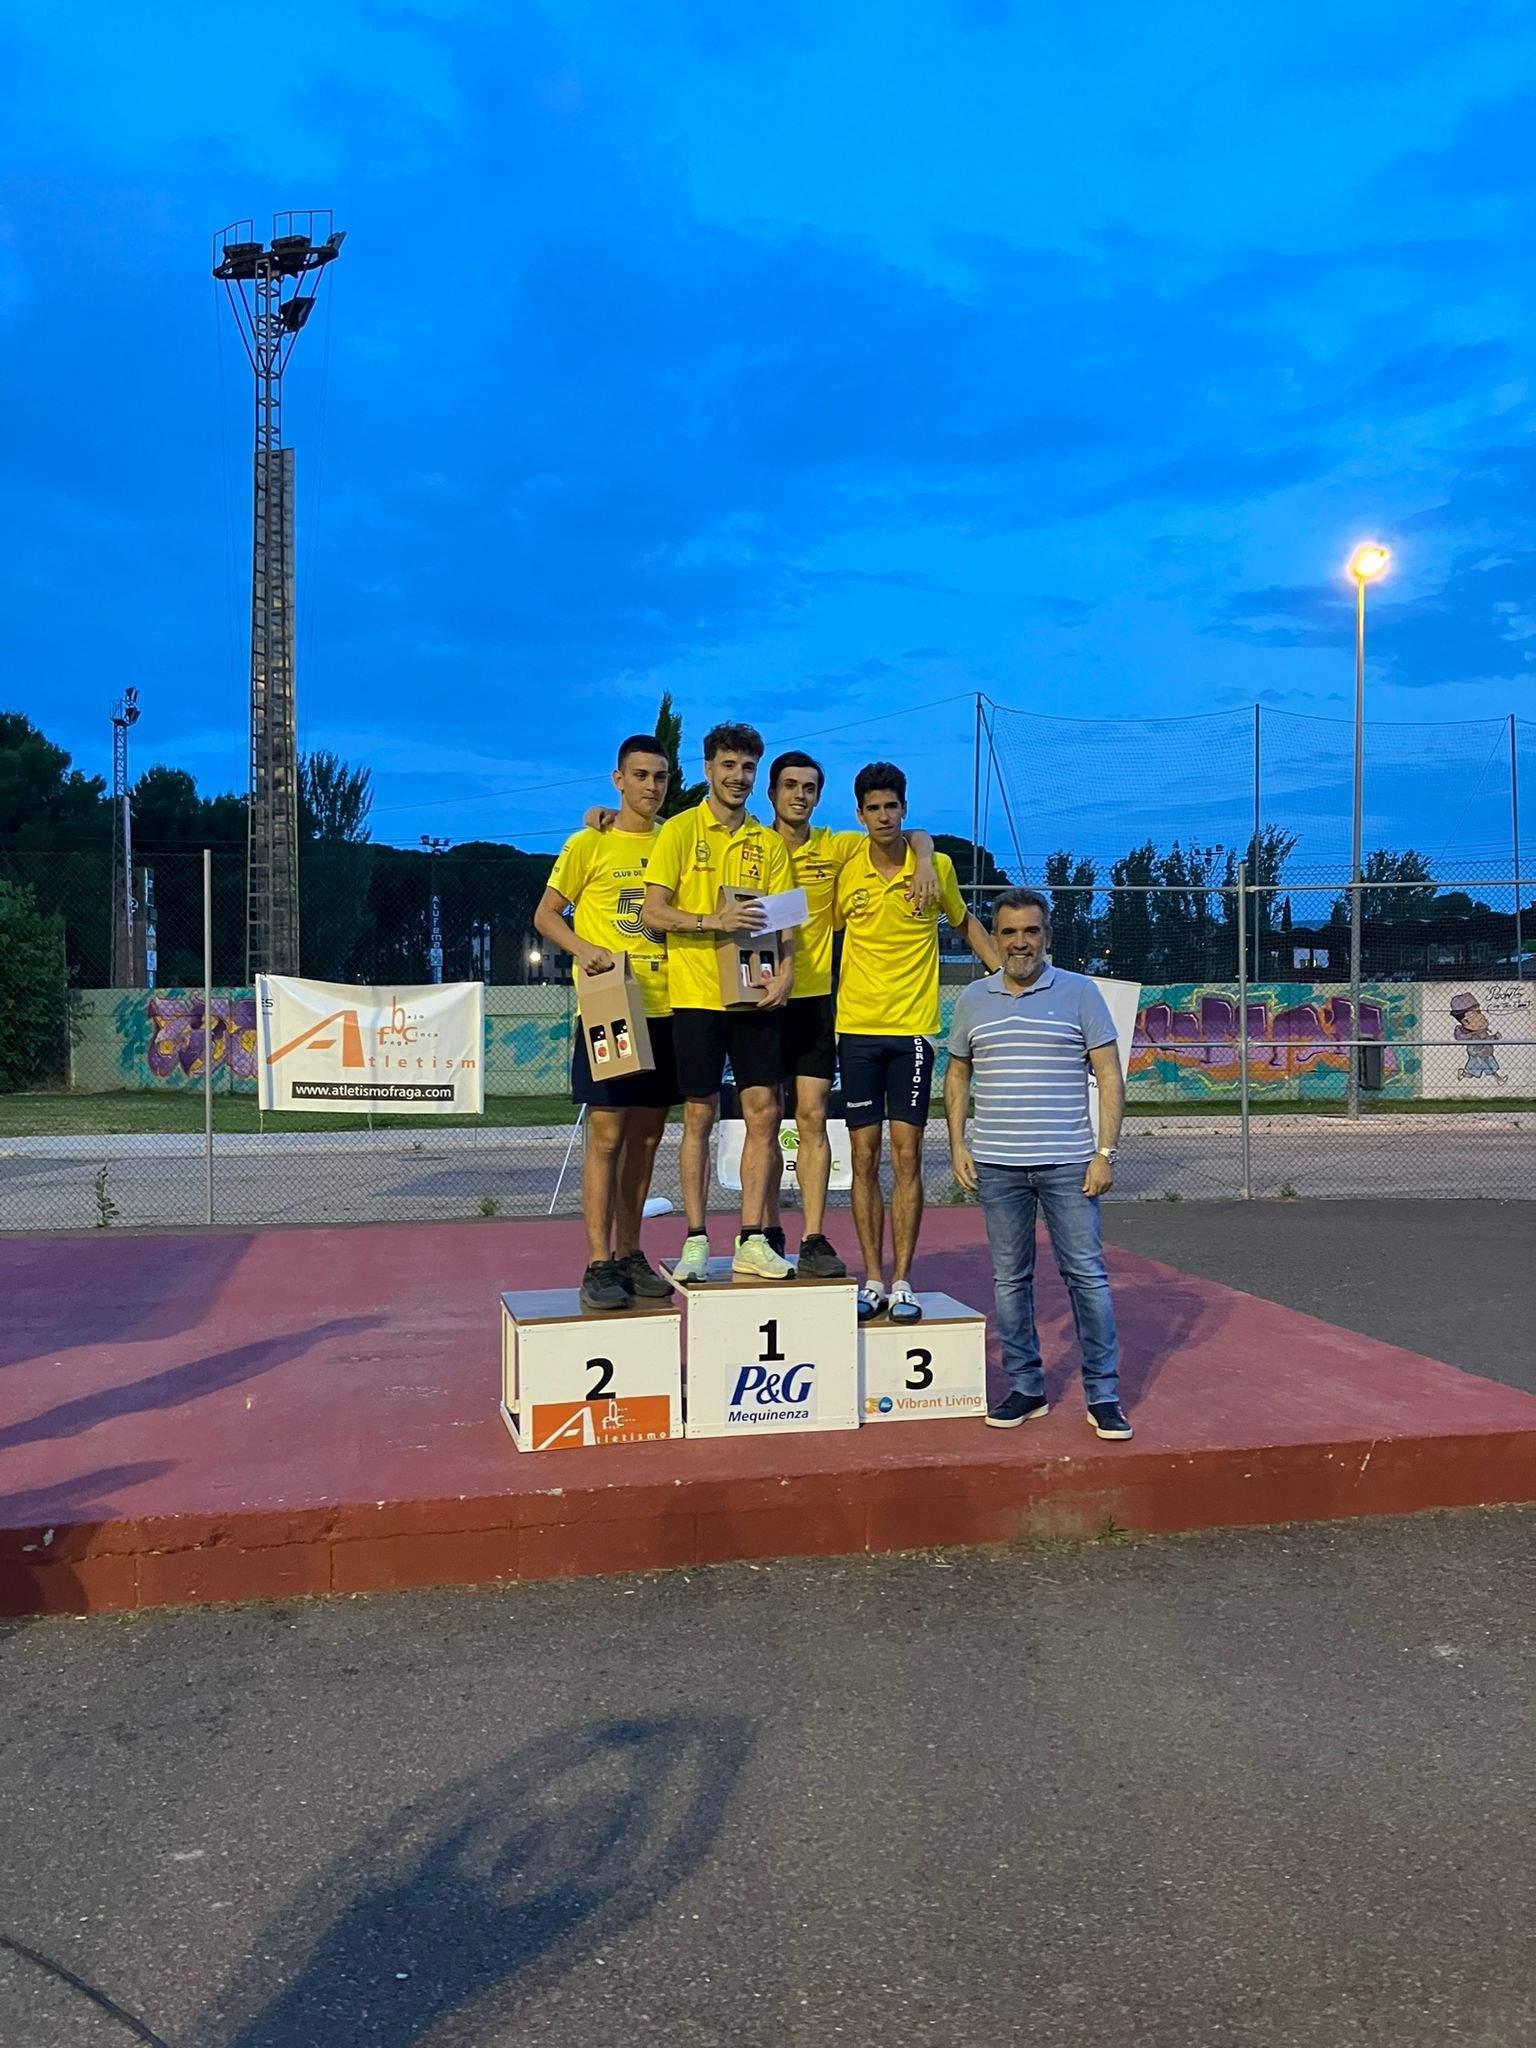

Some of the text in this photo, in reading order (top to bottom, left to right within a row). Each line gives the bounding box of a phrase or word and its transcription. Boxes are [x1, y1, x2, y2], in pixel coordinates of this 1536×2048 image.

[295, 1084, 452, 1100] www.atletismofraga.com
[759, 1319, 785, 1361] 1
[586, 1357, 616, 1401] 2
[730, 1363, 815, 1406] P&G
[905, 1348, 934, 1390] 3
[728, 1409, 809, 1424] Mequinenza
[896, 1394, 982, 1410] Vibrant Living
